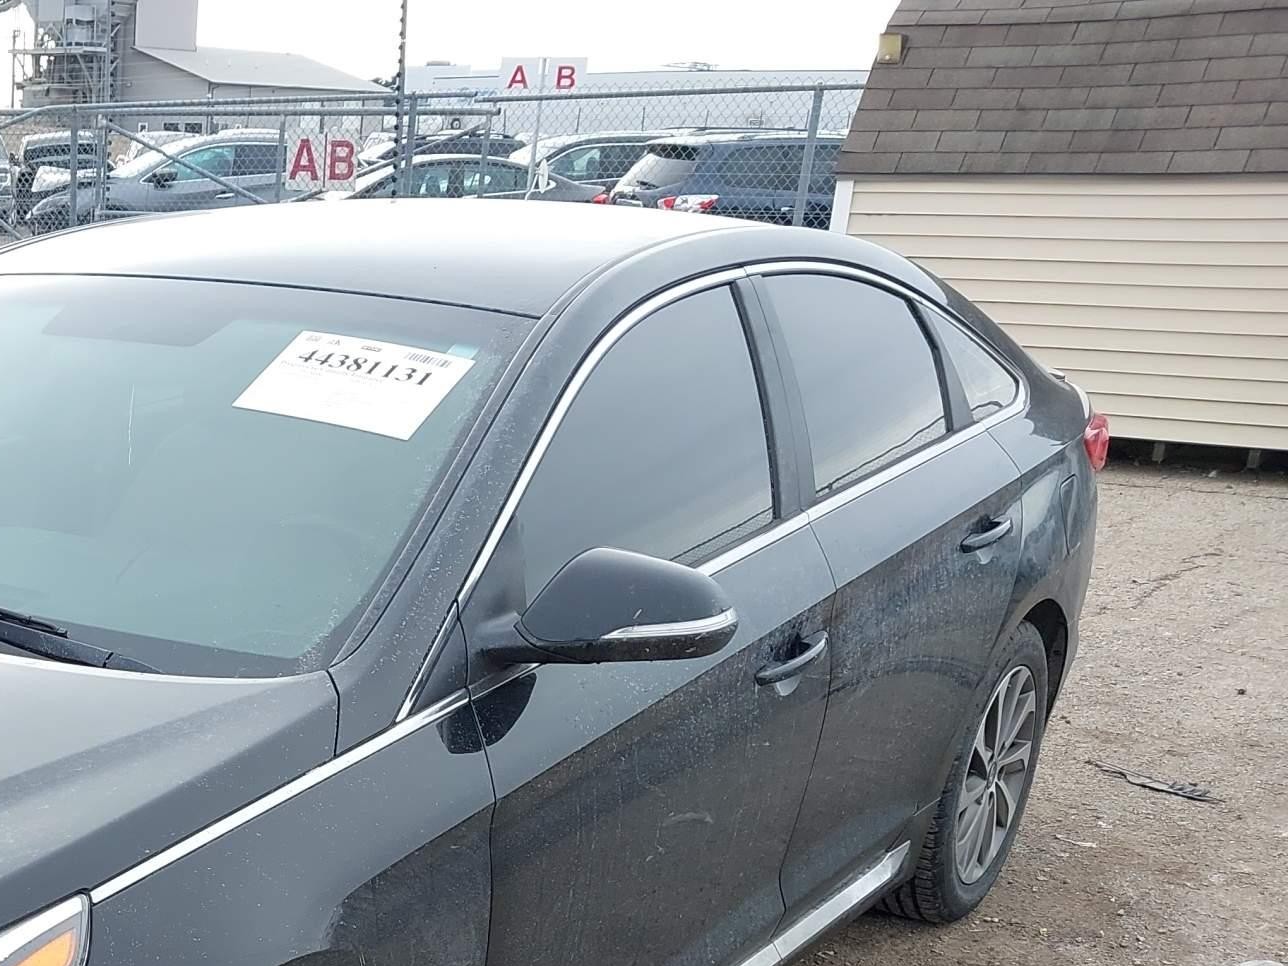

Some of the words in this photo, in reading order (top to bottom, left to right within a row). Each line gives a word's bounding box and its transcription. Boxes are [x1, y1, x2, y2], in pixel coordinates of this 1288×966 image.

[508, 65, 529, 90] A
[555, 66, 576, 90] B
[289, 138, 319, 181] A
[328, 140, 354, 181] B
[298, 350, 432, 385] 44381131
